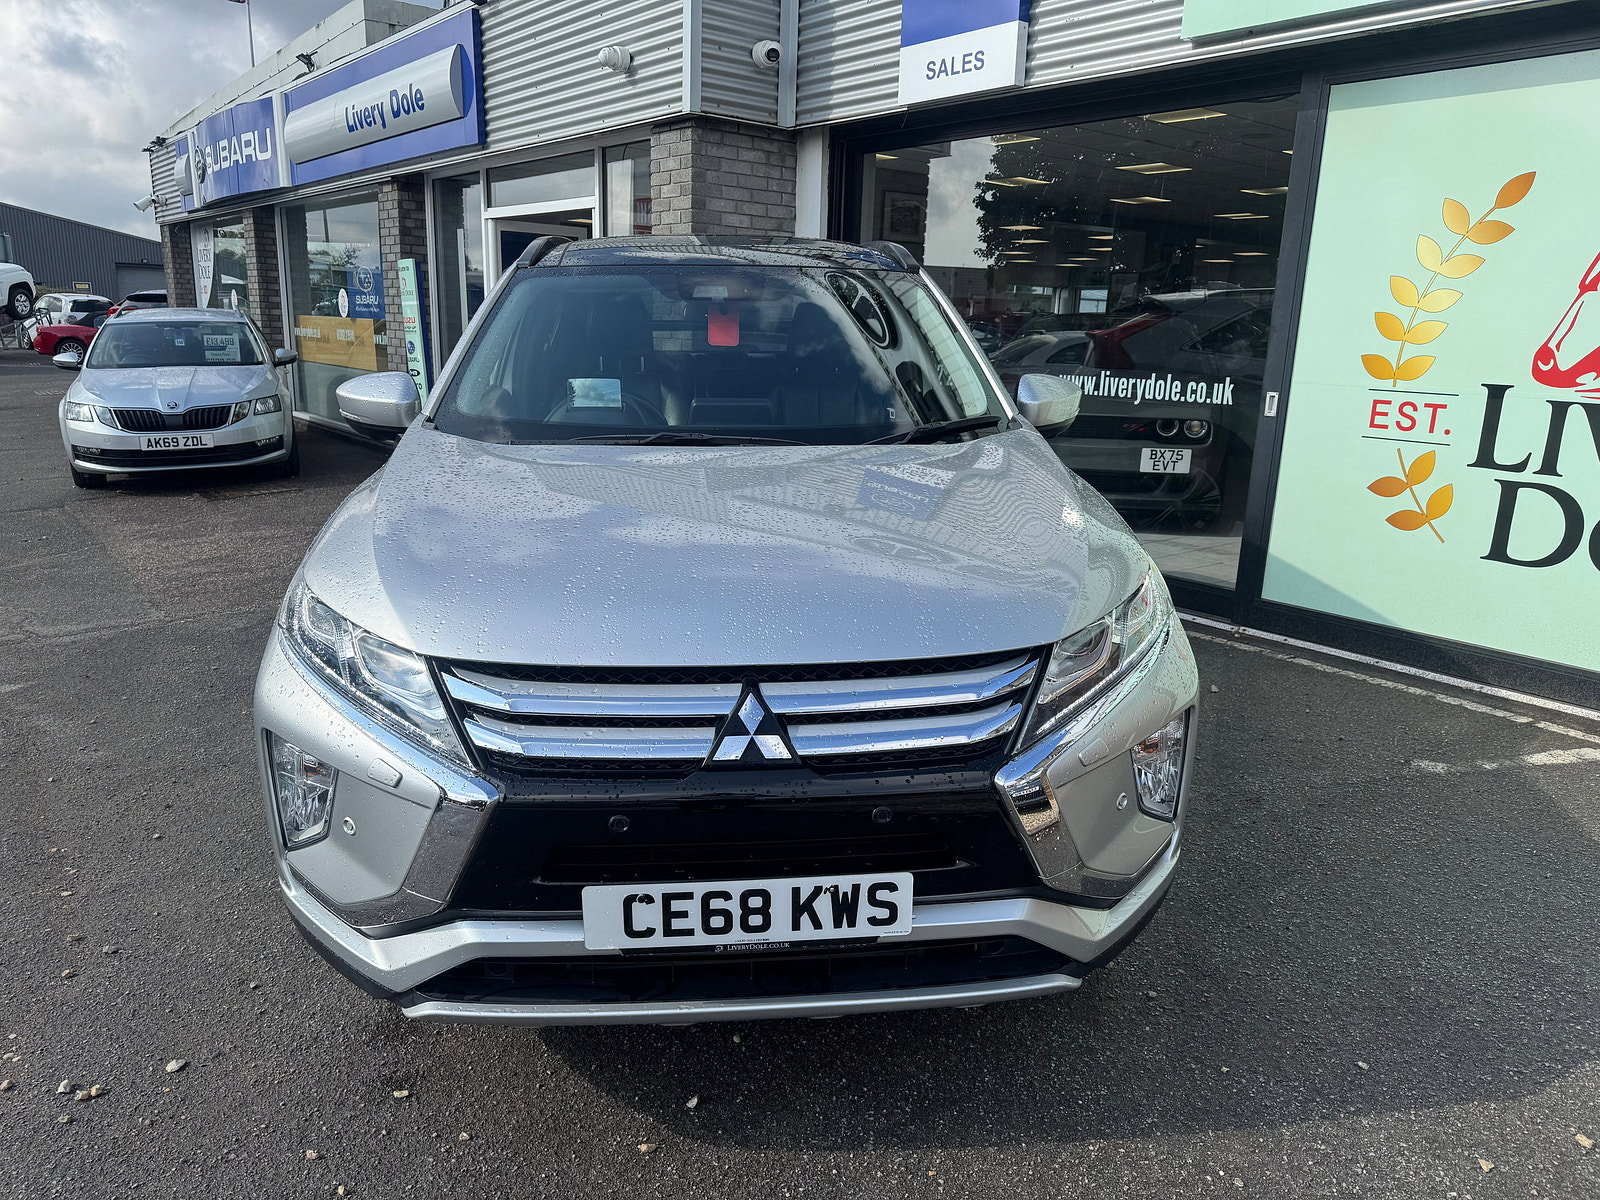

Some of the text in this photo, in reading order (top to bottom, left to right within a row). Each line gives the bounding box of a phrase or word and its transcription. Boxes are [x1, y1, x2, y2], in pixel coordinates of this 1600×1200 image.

[926, 50, 985, 80] SALES
[344, 83, 425, 134] Livery Dole
[204, 128, 272, 175] SUBARU
[197, 247, 212, 263] LIVERY
[198, 264, 211, 280] DOLE
[355, 295, 379, 305] SUBARU
[1059, 370, 1235, 405] ww.liverydole.co.uk
[1369, 399, 1451, 436] EST.
[147, 435, 208, 449] AK69 ZDL
[1149, 450, 1184, 461] BX75
[1152, 460, 1179, 472] EVT
[1480, 479, 1600, 568] D
[622, 881, 899, 939] CE68 KWS
